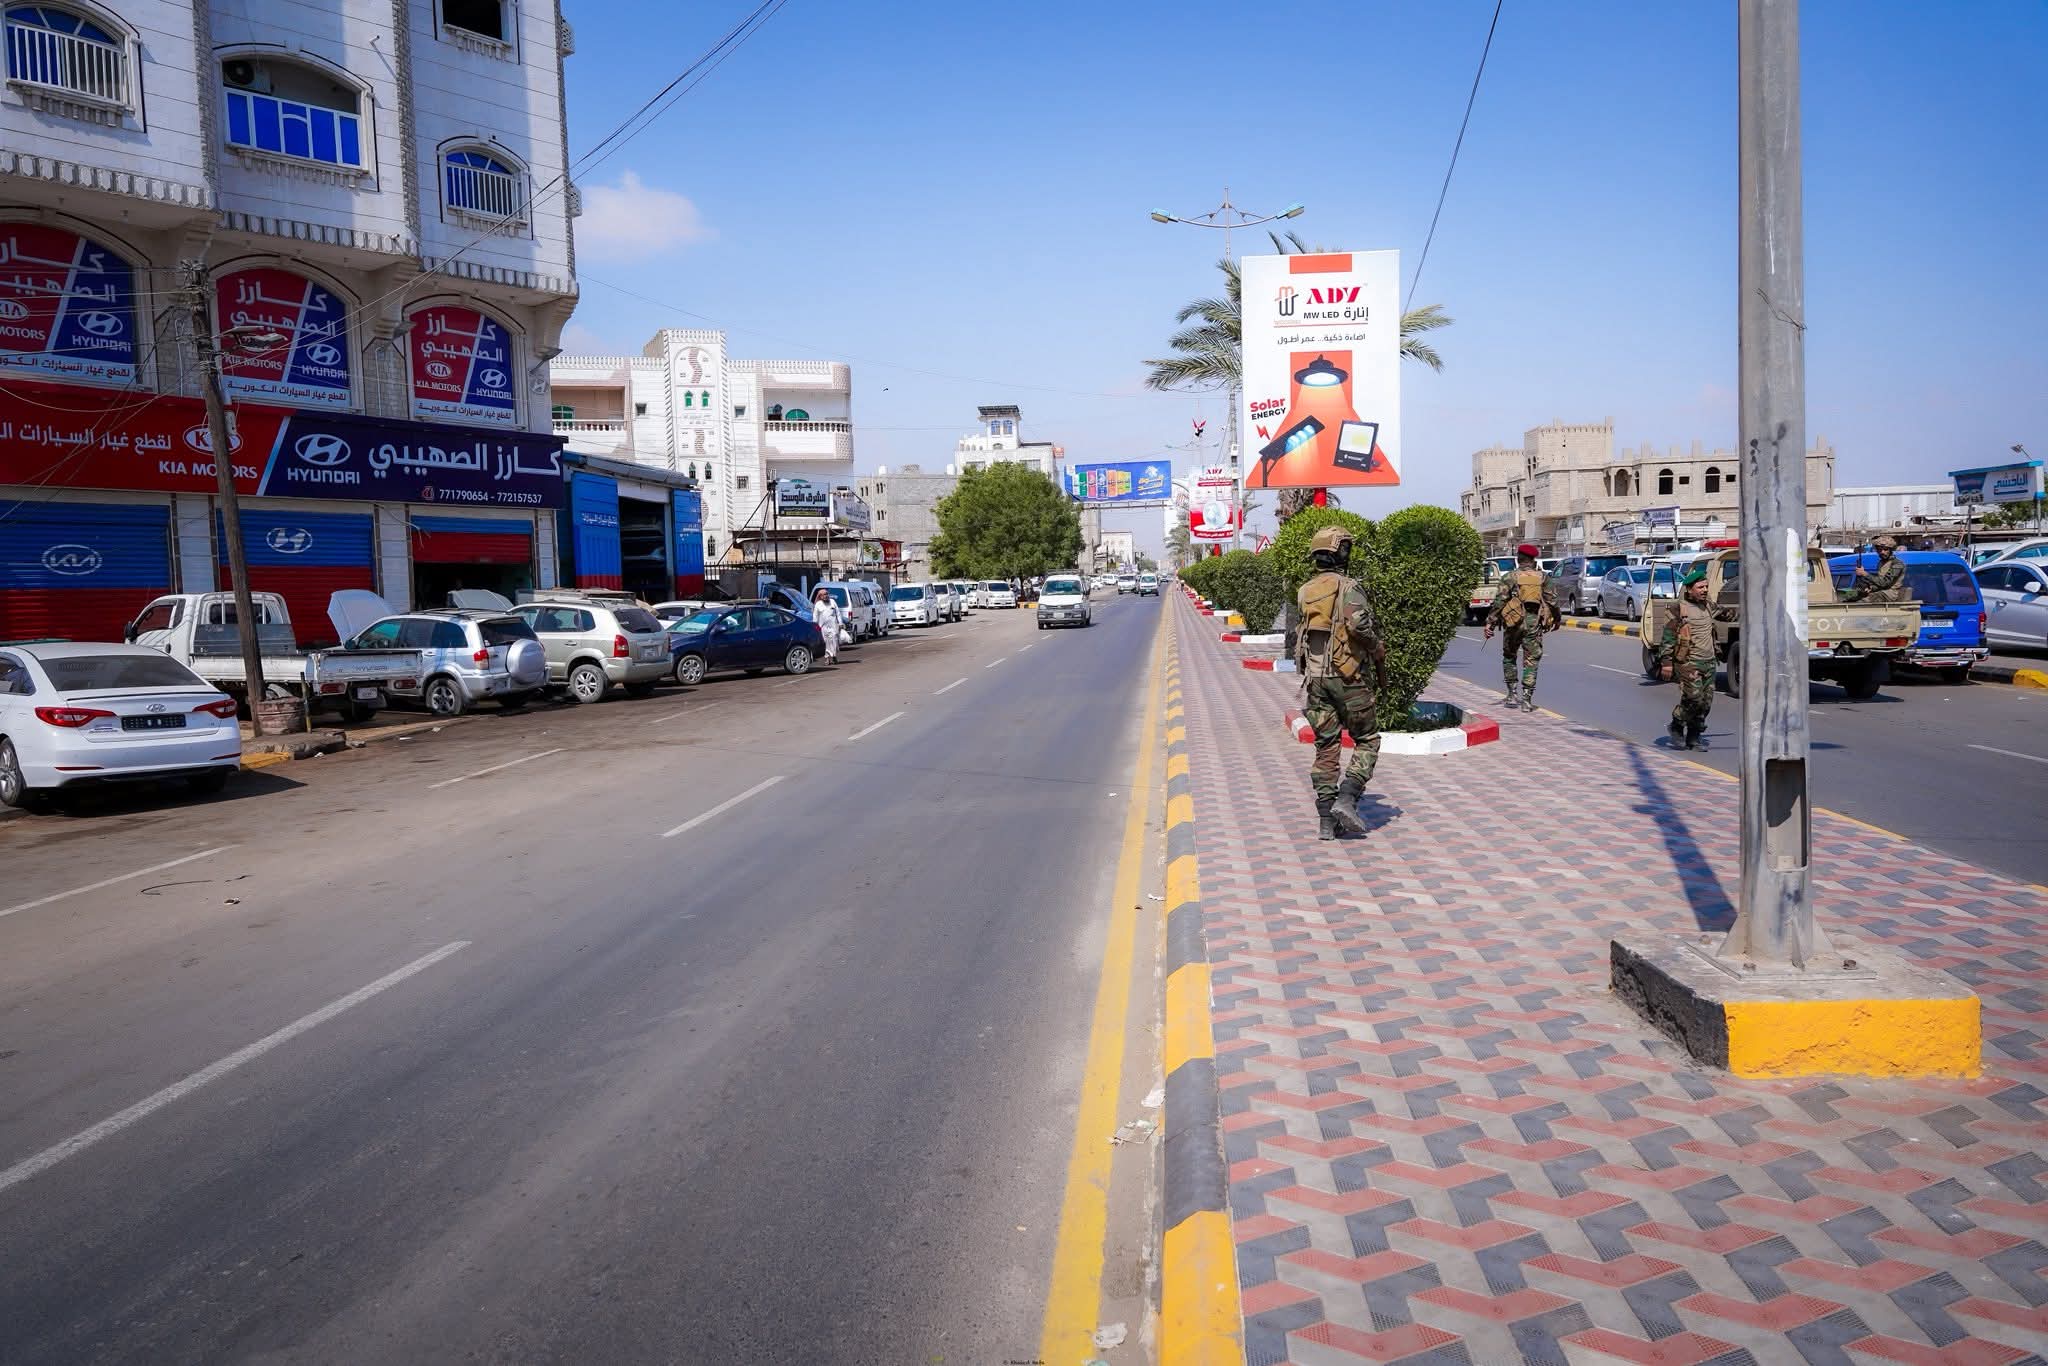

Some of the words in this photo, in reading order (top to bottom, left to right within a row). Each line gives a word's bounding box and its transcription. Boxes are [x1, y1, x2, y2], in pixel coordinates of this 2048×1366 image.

[1303, 312, 1320, 320] MW
[1322, 311, 1340, 319] LED
[1343, 306, 1369, 322] إنارة
[71, 334, 132, 353] HYUNDAI
[1301, 336, 1316, 345] عمر
[301, 365, 349, 380] HYUNDAI
[432, 382, 462, 393] MOTORS
[476, 387, 512, 400] HYUNDAI
[1250, 397, 1286, 414] Solar
[1251, 407, 1287, 421] ENERGY
[19, 423, 96, 447] السيارات
[99, 431, 130, 451] غيار
[134, 434, 173, 456] لقطع
[368, 441, 489, 480] الصهيبي
[494, 445, 561, 481] كارز
[159, 460, 188, 475] KIA
[191, 463, 258, 479] MOORS
[287, 467, 361, 485] HYUNDAI
[439, 488, 489, 502] 771790654
[496, 492, 544, 505] 772157537
[806, 490, 826, 505] الشرق
